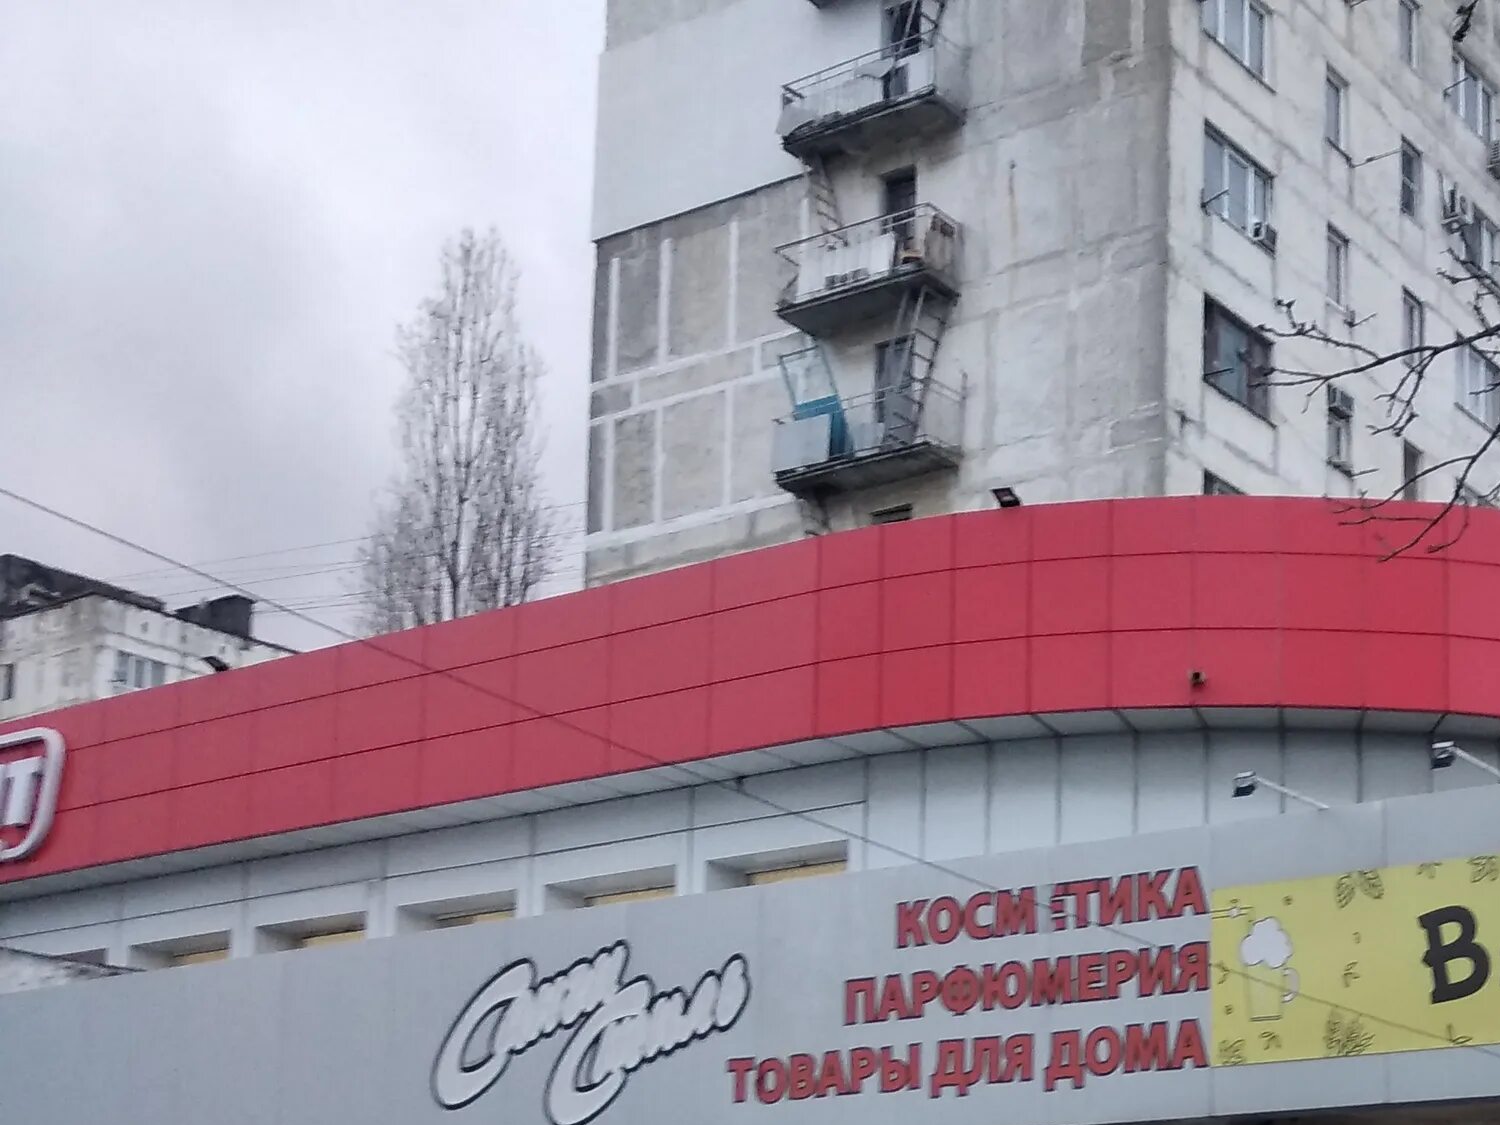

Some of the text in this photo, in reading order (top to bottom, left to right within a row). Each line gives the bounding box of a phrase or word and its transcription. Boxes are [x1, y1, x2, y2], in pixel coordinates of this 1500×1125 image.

[843, 941, 1209, 1026] ПАРФЮМЕРИЯ
[726, 1018, 1209, 1105] ТОВАРЫ ДЛЯ ДОМА
